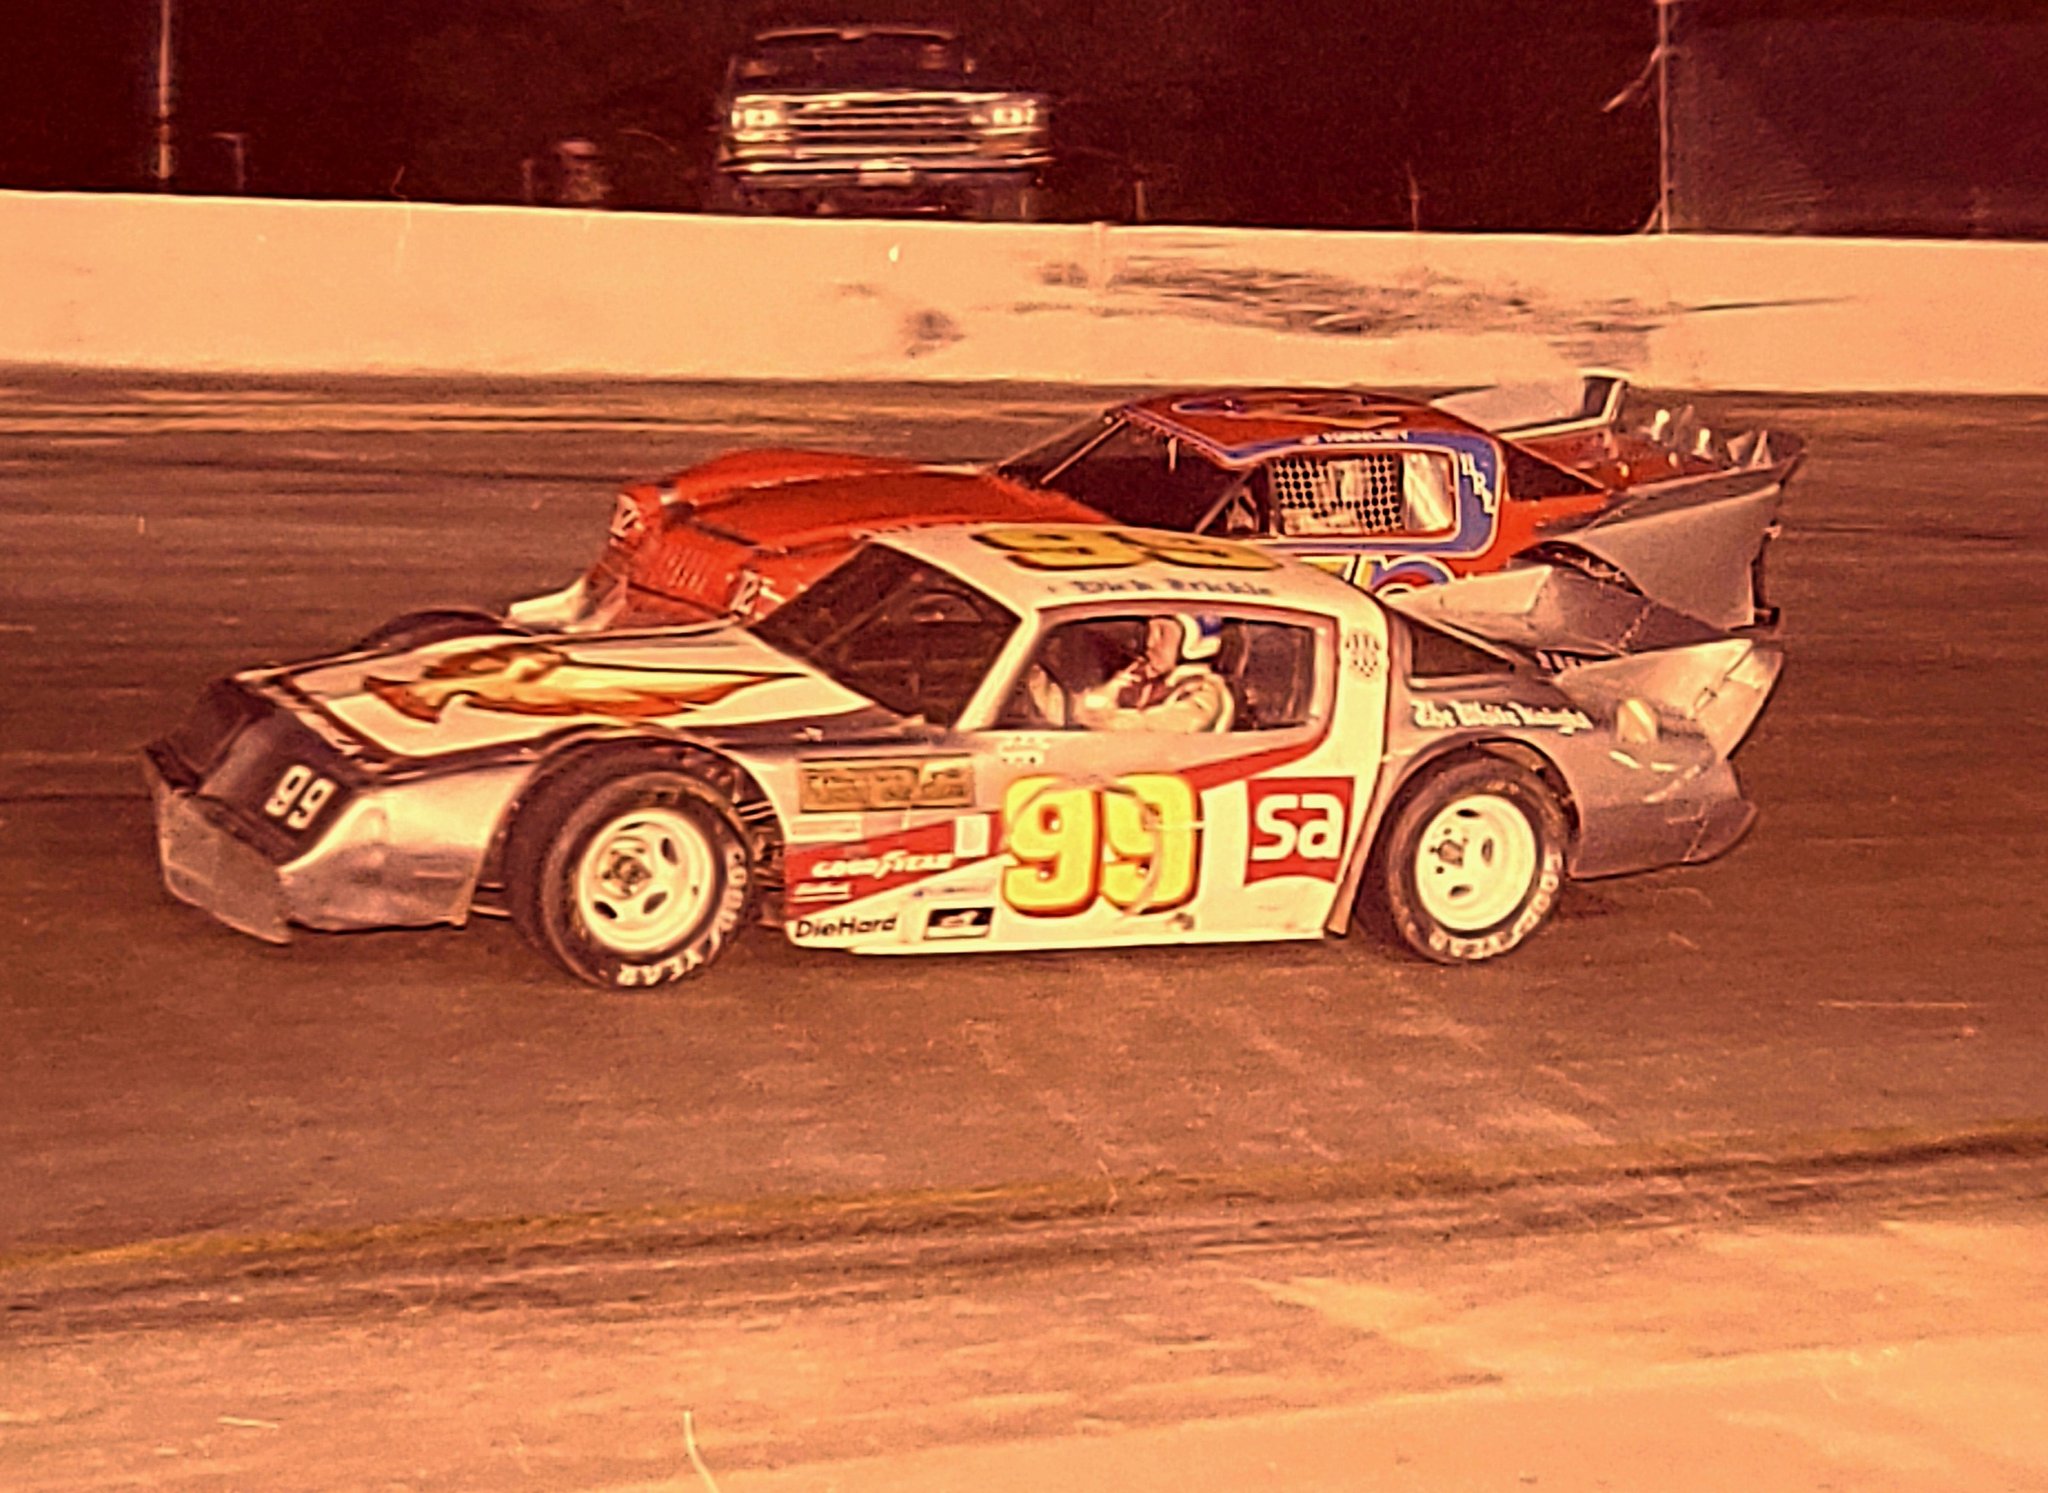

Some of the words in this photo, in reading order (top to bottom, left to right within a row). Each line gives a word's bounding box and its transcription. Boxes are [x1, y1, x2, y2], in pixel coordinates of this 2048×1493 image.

[264, 764, 338, 830] 99
[1000, 772, 1202, 918] 99
[795, 912, 898, 940] DieHard
